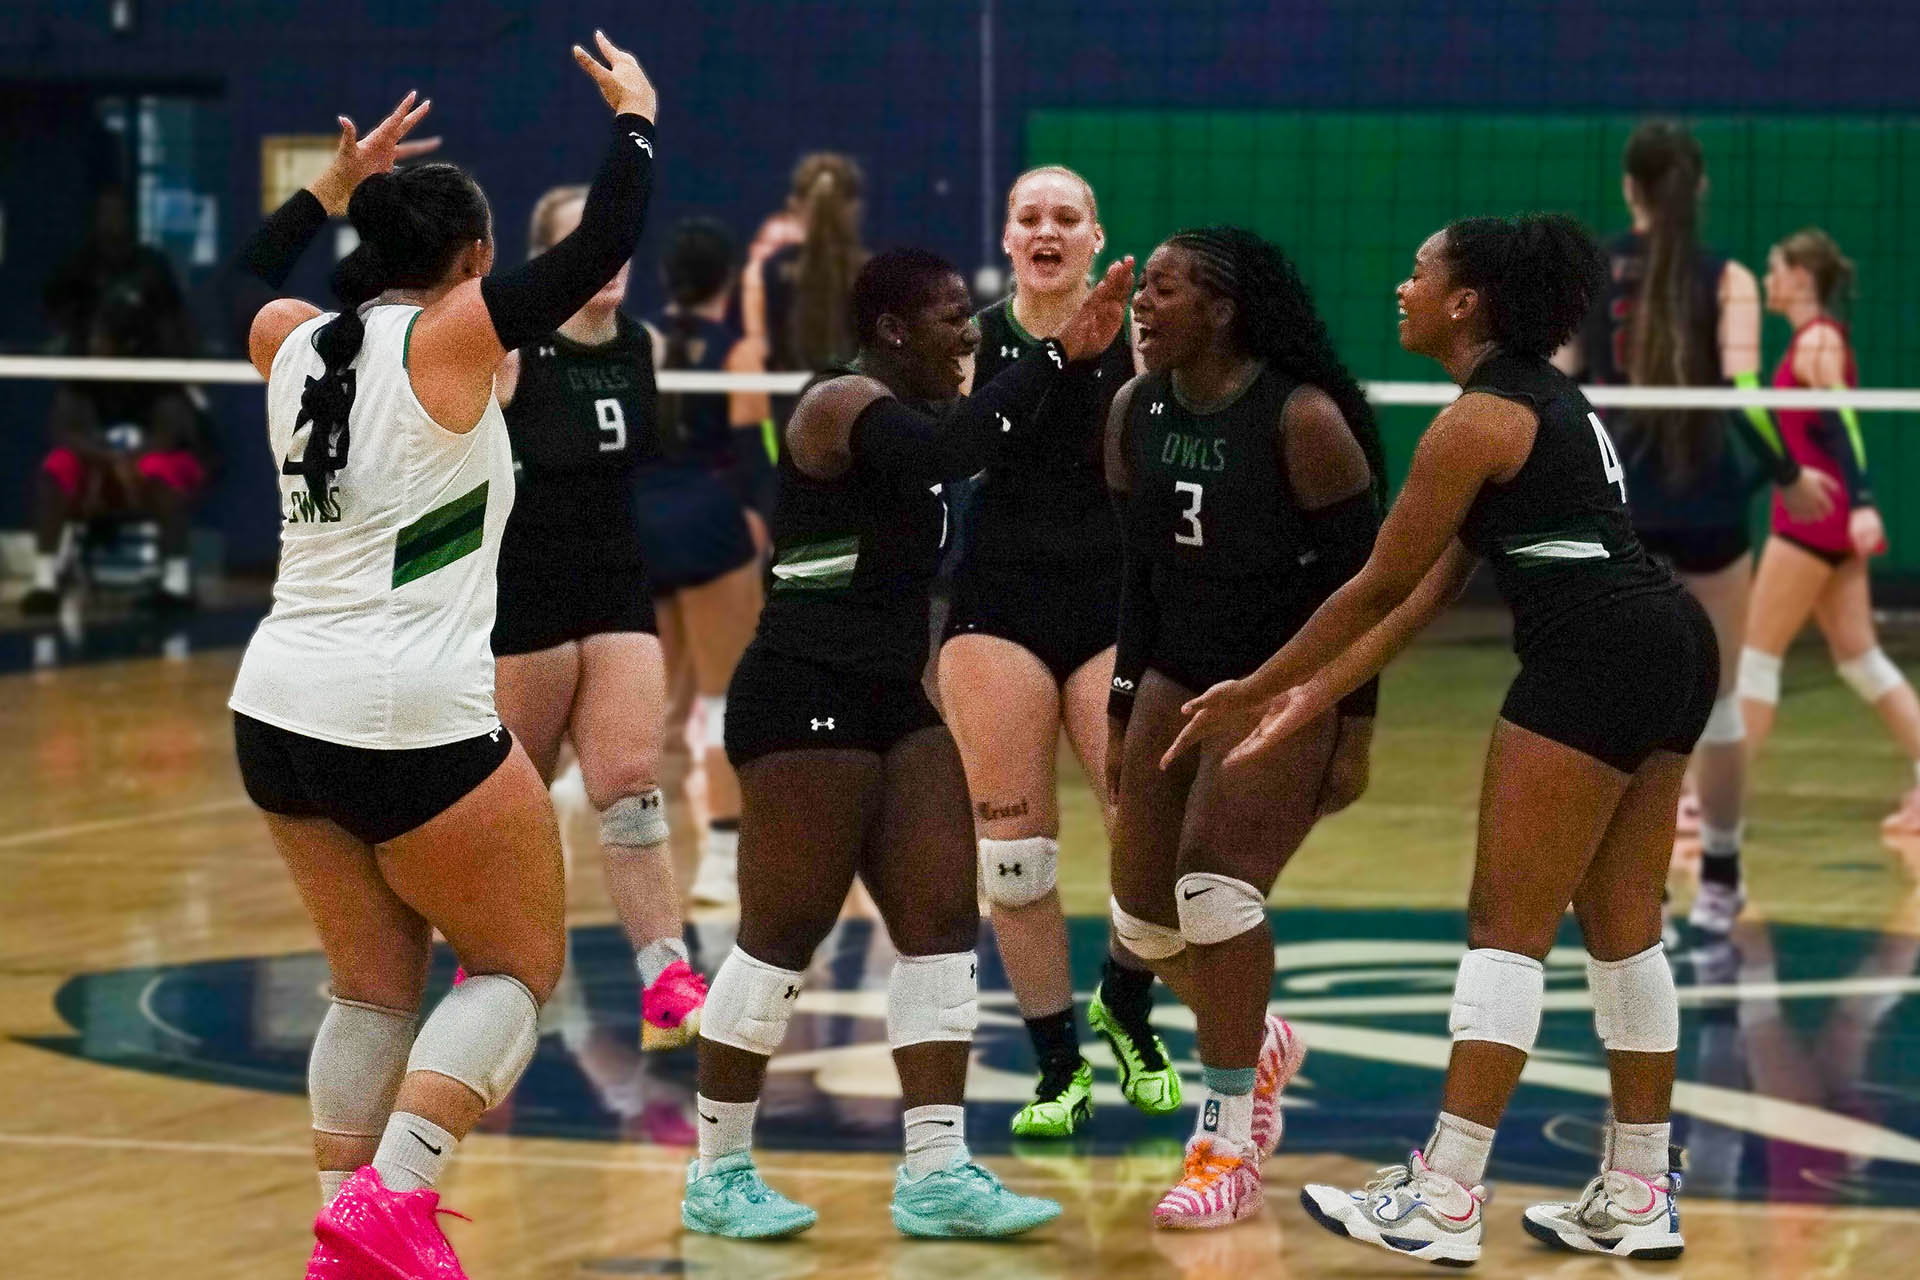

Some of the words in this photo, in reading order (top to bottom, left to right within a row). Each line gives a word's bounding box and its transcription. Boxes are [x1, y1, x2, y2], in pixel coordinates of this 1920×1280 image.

[594, 398, 626, 451] 9
[1161, 432, 1225, 470] OWLS
[1587, 411, 1626, 503] 4
[1174, 480, 1203, 546] 3
